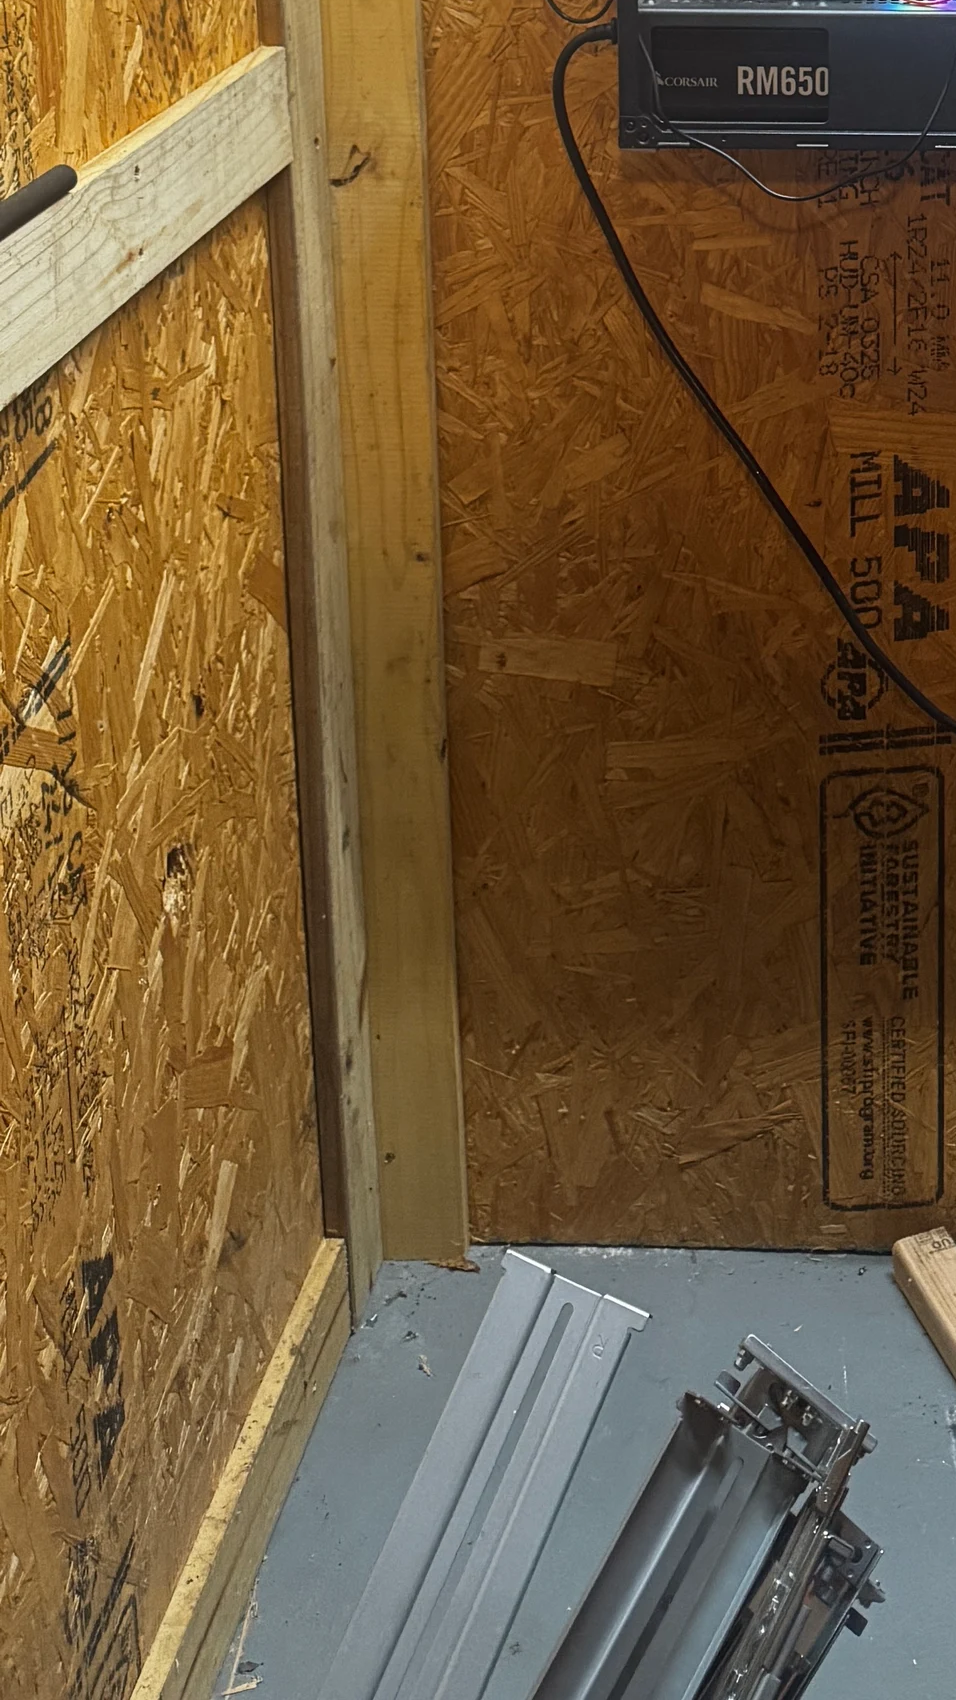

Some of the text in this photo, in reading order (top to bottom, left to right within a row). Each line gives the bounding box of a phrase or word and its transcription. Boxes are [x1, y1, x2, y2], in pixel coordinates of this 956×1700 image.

[664, 76, 718, 88] CORSAIR
[737, 65, 829, 96] RM650
[817, 268, 838, 300] PS
[859, 255, 880, 304] CSA
[930, 259, 950, 320] 11.0
[817, 316, 838, 377] 2-18
[907, 369, 927, 416] W24
[849, 450, 882, 630] MILL 500
[893, 454, 950, 642] APA
[837, 638, 867, 721] APA
[859, 844, 878, 967] INITIATIVE
[883, 844, 900, 965] FORESTRY
[902, 839, 919, 1000] SUSTAINABLE
[856, 1016, 876, 1180] www.sfiprogram.org
[888, 1016, 906, 1197] CERTIFIED SOURCING
[81, 1251, 125, 1492] APA
